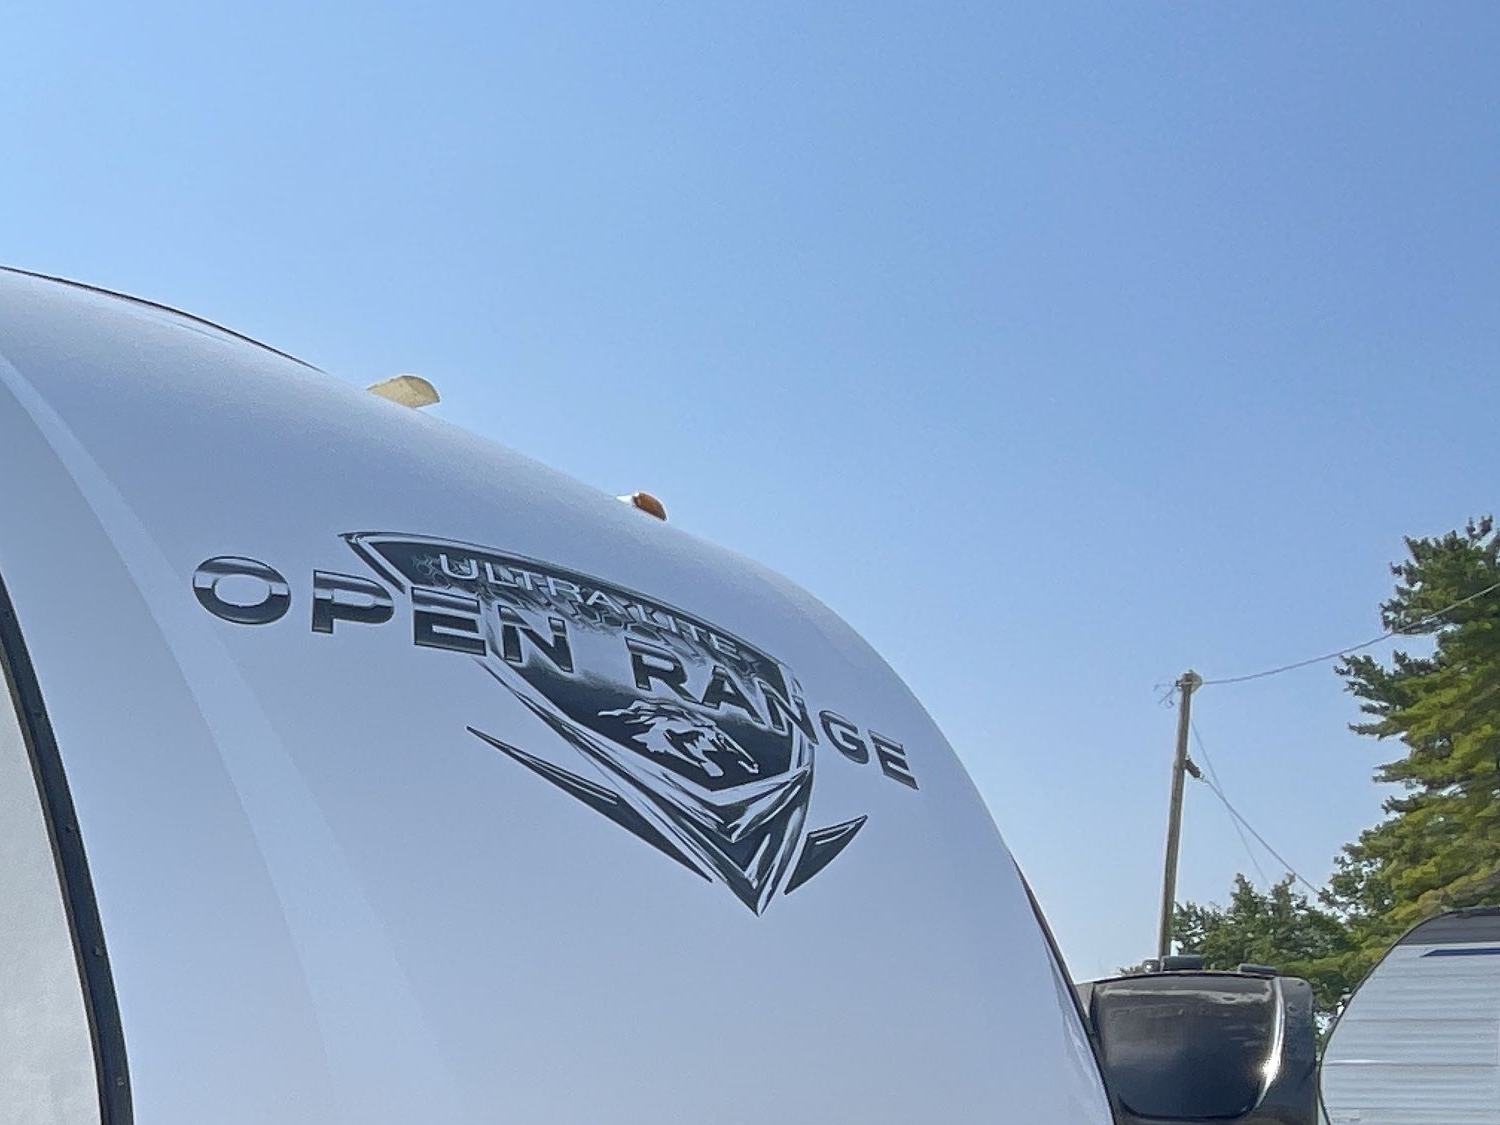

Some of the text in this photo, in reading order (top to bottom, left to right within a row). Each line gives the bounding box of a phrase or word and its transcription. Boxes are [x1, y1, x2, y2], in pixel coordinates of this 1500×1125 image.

[191, 554, 920, 790] OPEN RANGE
[438, 553, 742, 659] ULTRA LITE
